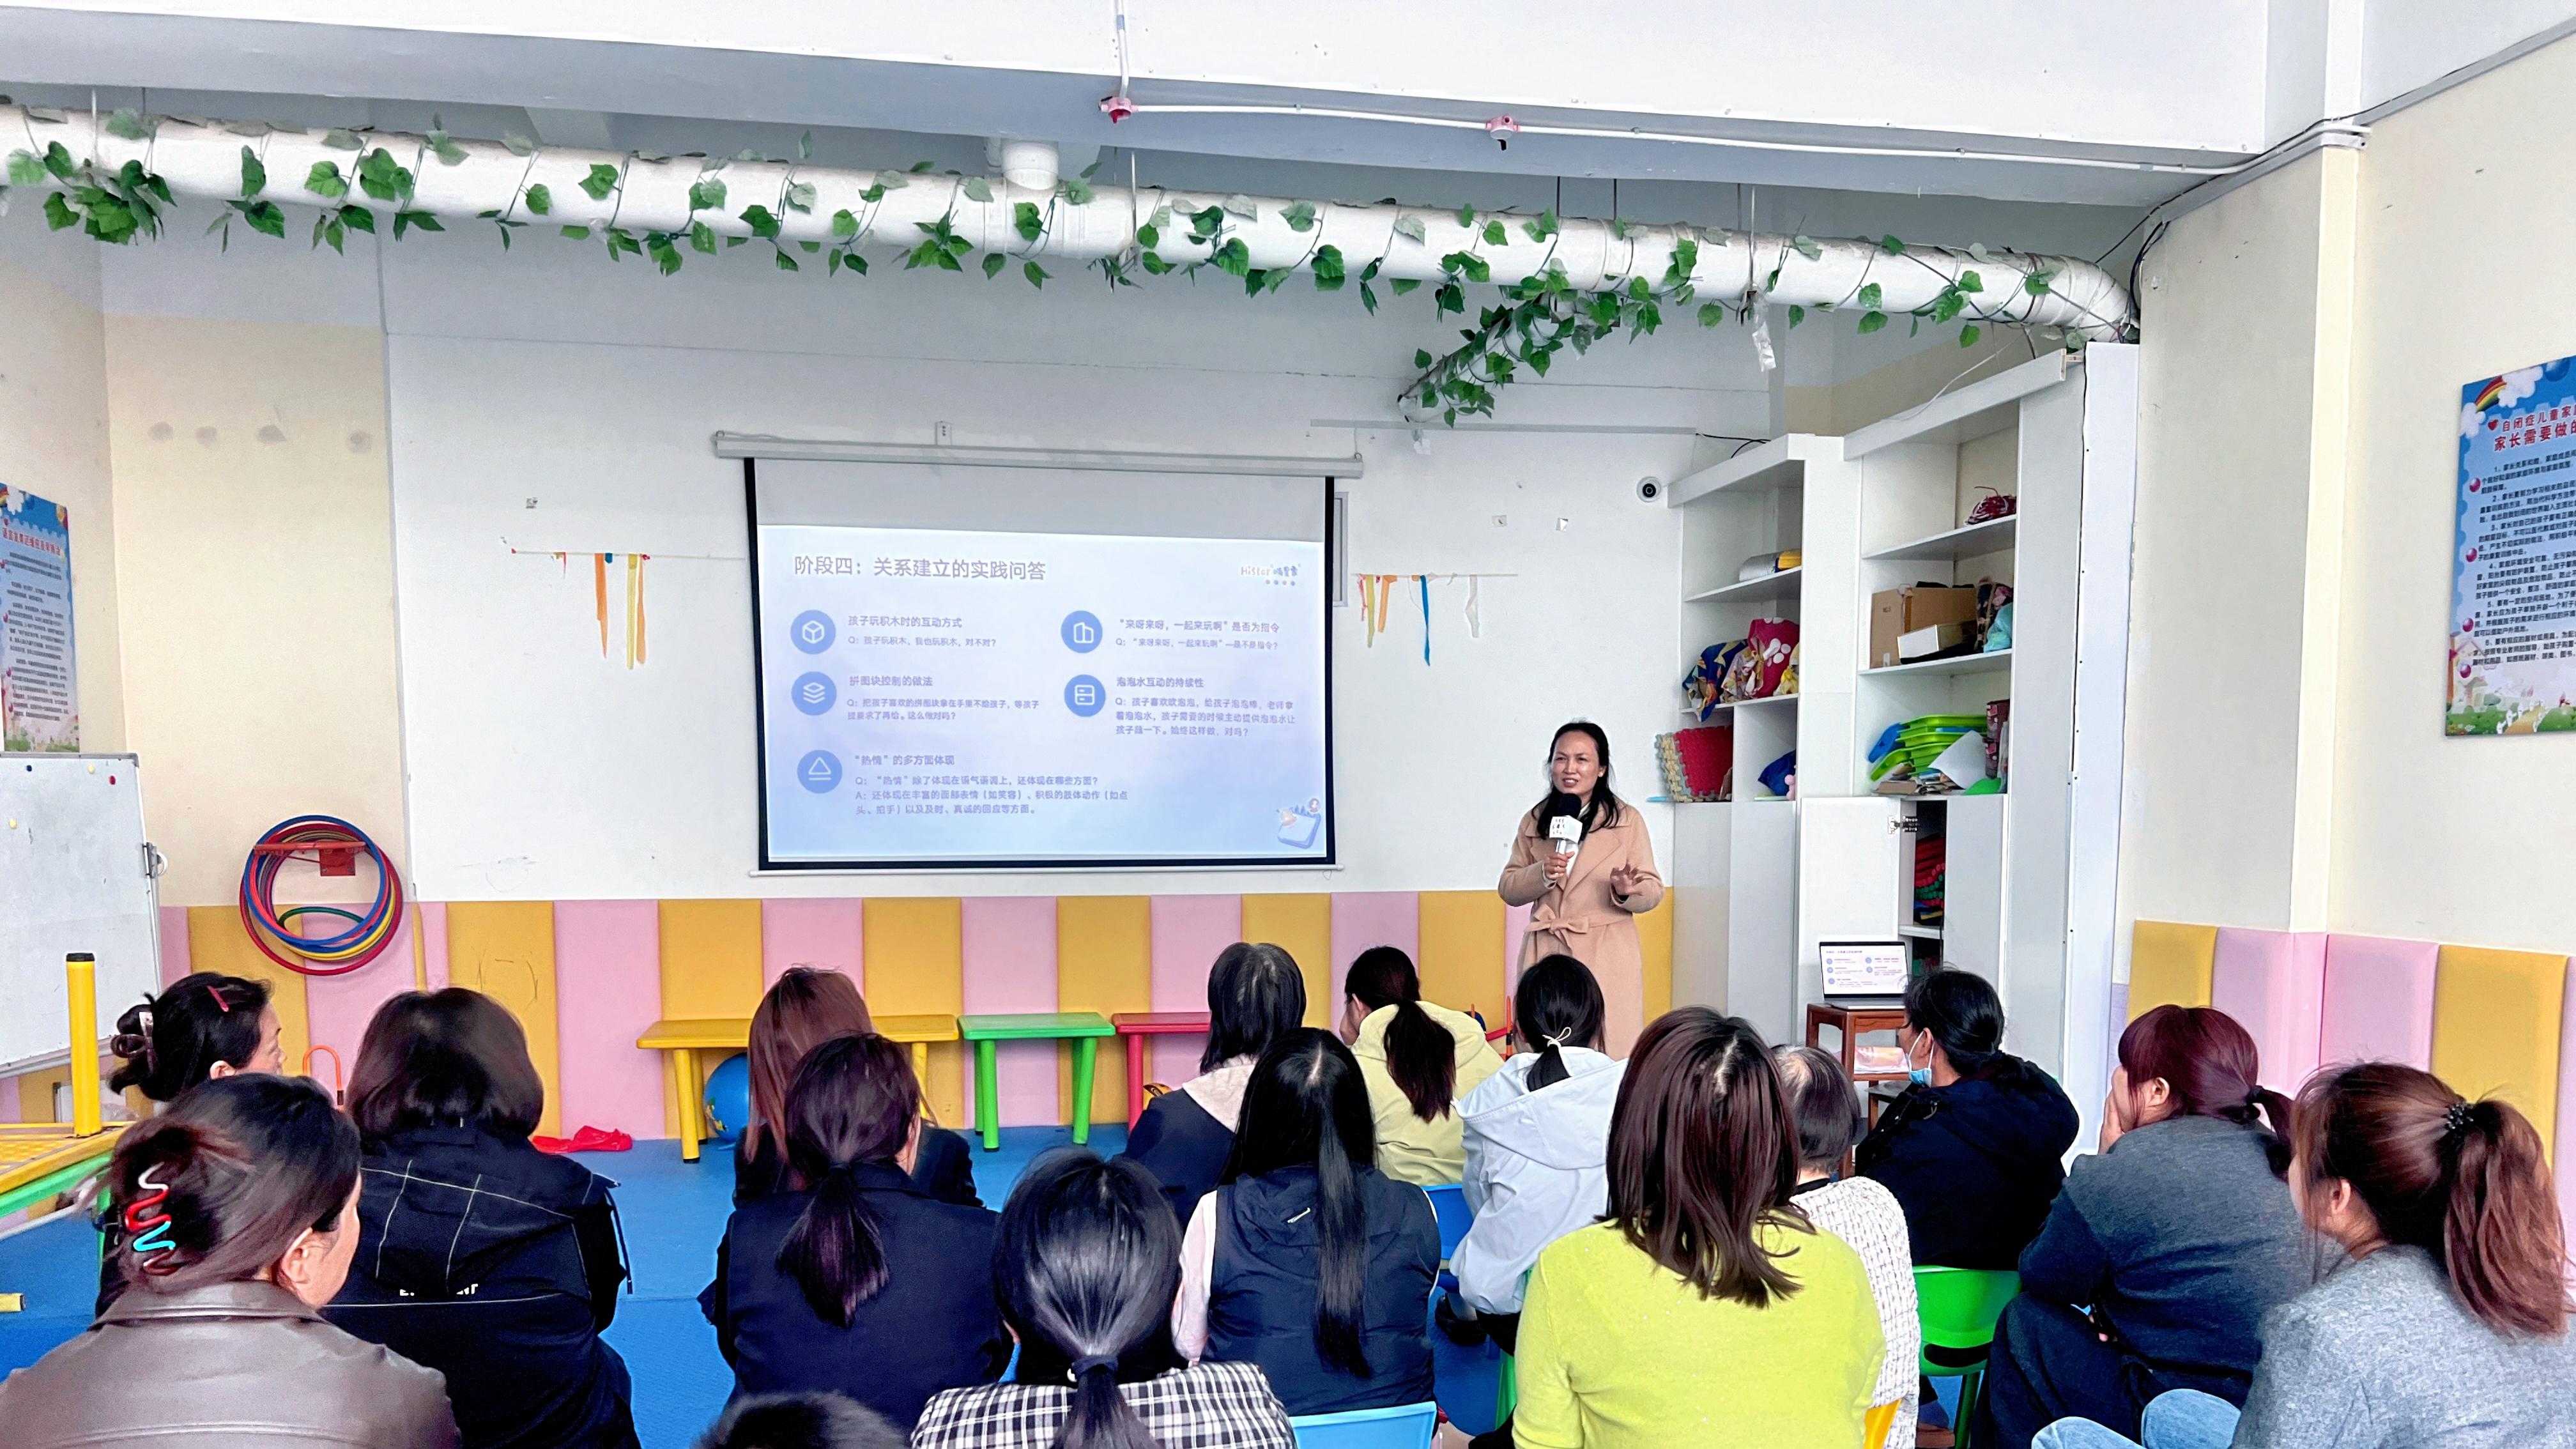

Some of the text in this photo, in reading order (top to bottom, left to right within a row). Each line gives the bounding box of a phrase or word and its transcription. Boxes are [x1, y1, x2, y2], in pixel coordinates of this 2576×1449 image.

[2503, 404, 2576, 432] 自闭症儿童家
[794, 556, 1046, 580] 阶段四：关系建立的实践问答
[848, 615, 962, 629] 孩子玩积木时的互动方式
[849, 675, 933, 687] 拼图块控制的做法
[1116, 677, 1204, 688] 泡泡水互动的持续性
